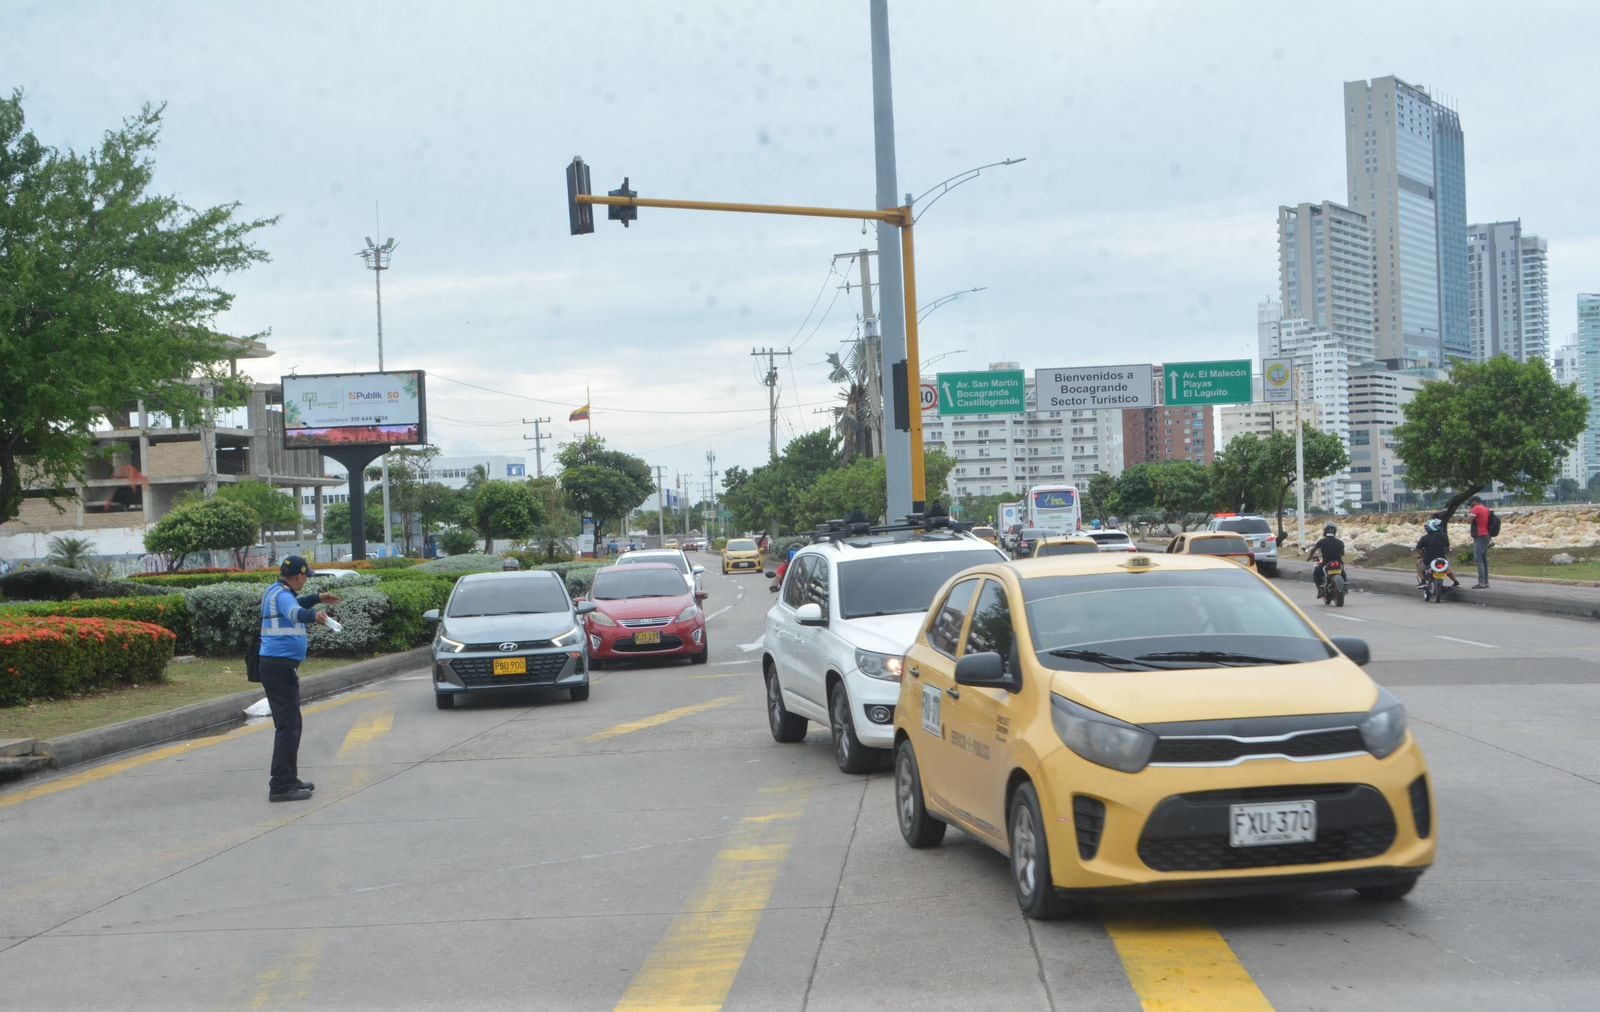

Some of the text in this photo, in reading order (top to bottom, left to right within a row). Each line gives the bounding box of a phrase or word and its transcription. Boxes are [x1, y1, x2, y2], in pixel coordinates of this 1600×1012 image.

[1054, 371, 1134, 382] Bienvenidos a
[1183, 369, 1247, 379] Av. El Malecón
[956, 381, 970, 389] Av.
[971, 380, 989, 388] San
[1061, 383, 1128, 395] Bocagrande
[1183, 380, 1212, 389] Playas
[356, 391, 383, 400] Publik
[957, 388, 1010, 399] Bocagrande
[1194, 389, 1228, 398] Laguito
[957, 397, 1020, 407] Castillogrande
[1050, 396, 1087, 406] Sector
